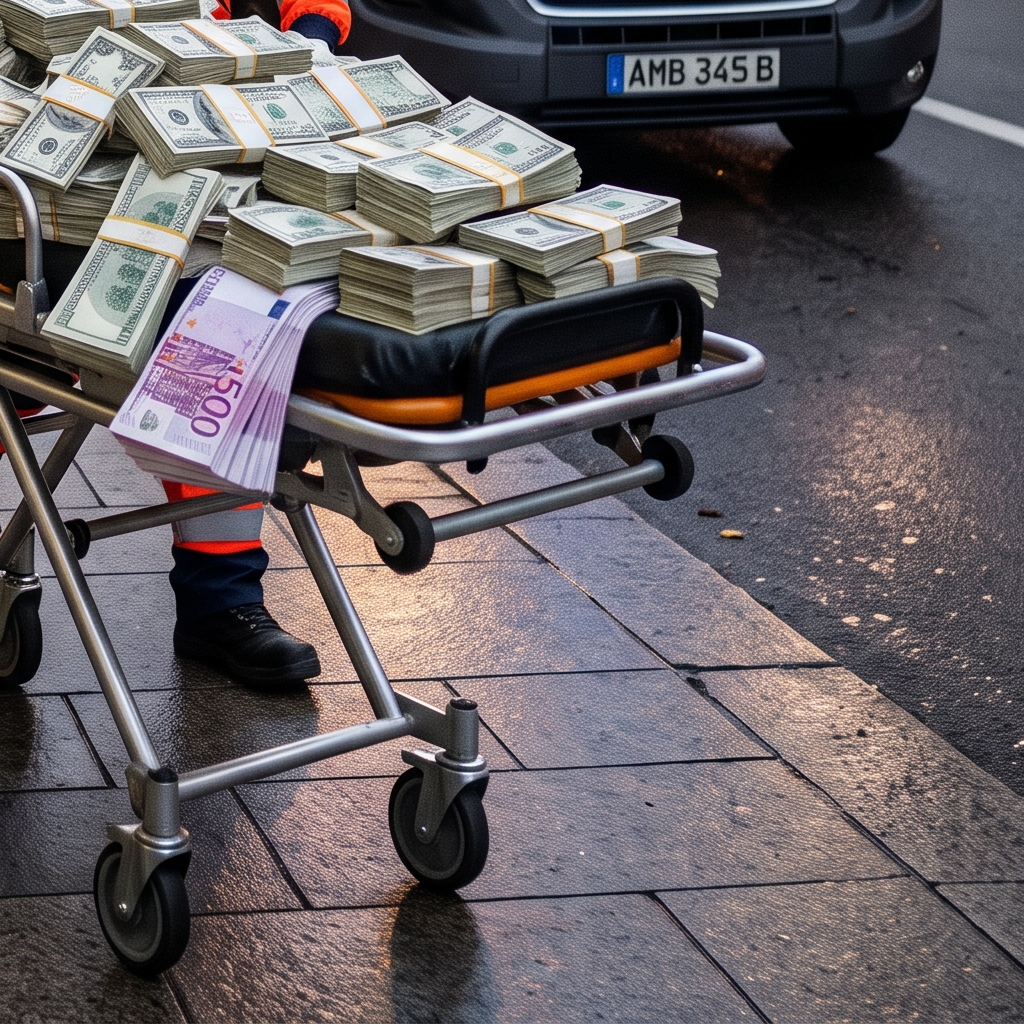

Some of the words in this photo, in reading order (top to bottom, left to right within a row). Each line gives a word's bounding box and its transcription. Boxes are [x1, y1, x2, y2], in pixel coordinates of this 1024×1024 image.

[628, 58, 685, 87] AMB
[695, 55, 748, 85] 345
[756, 55, 774, 82] B
[190, 377, 243, 438] 500
